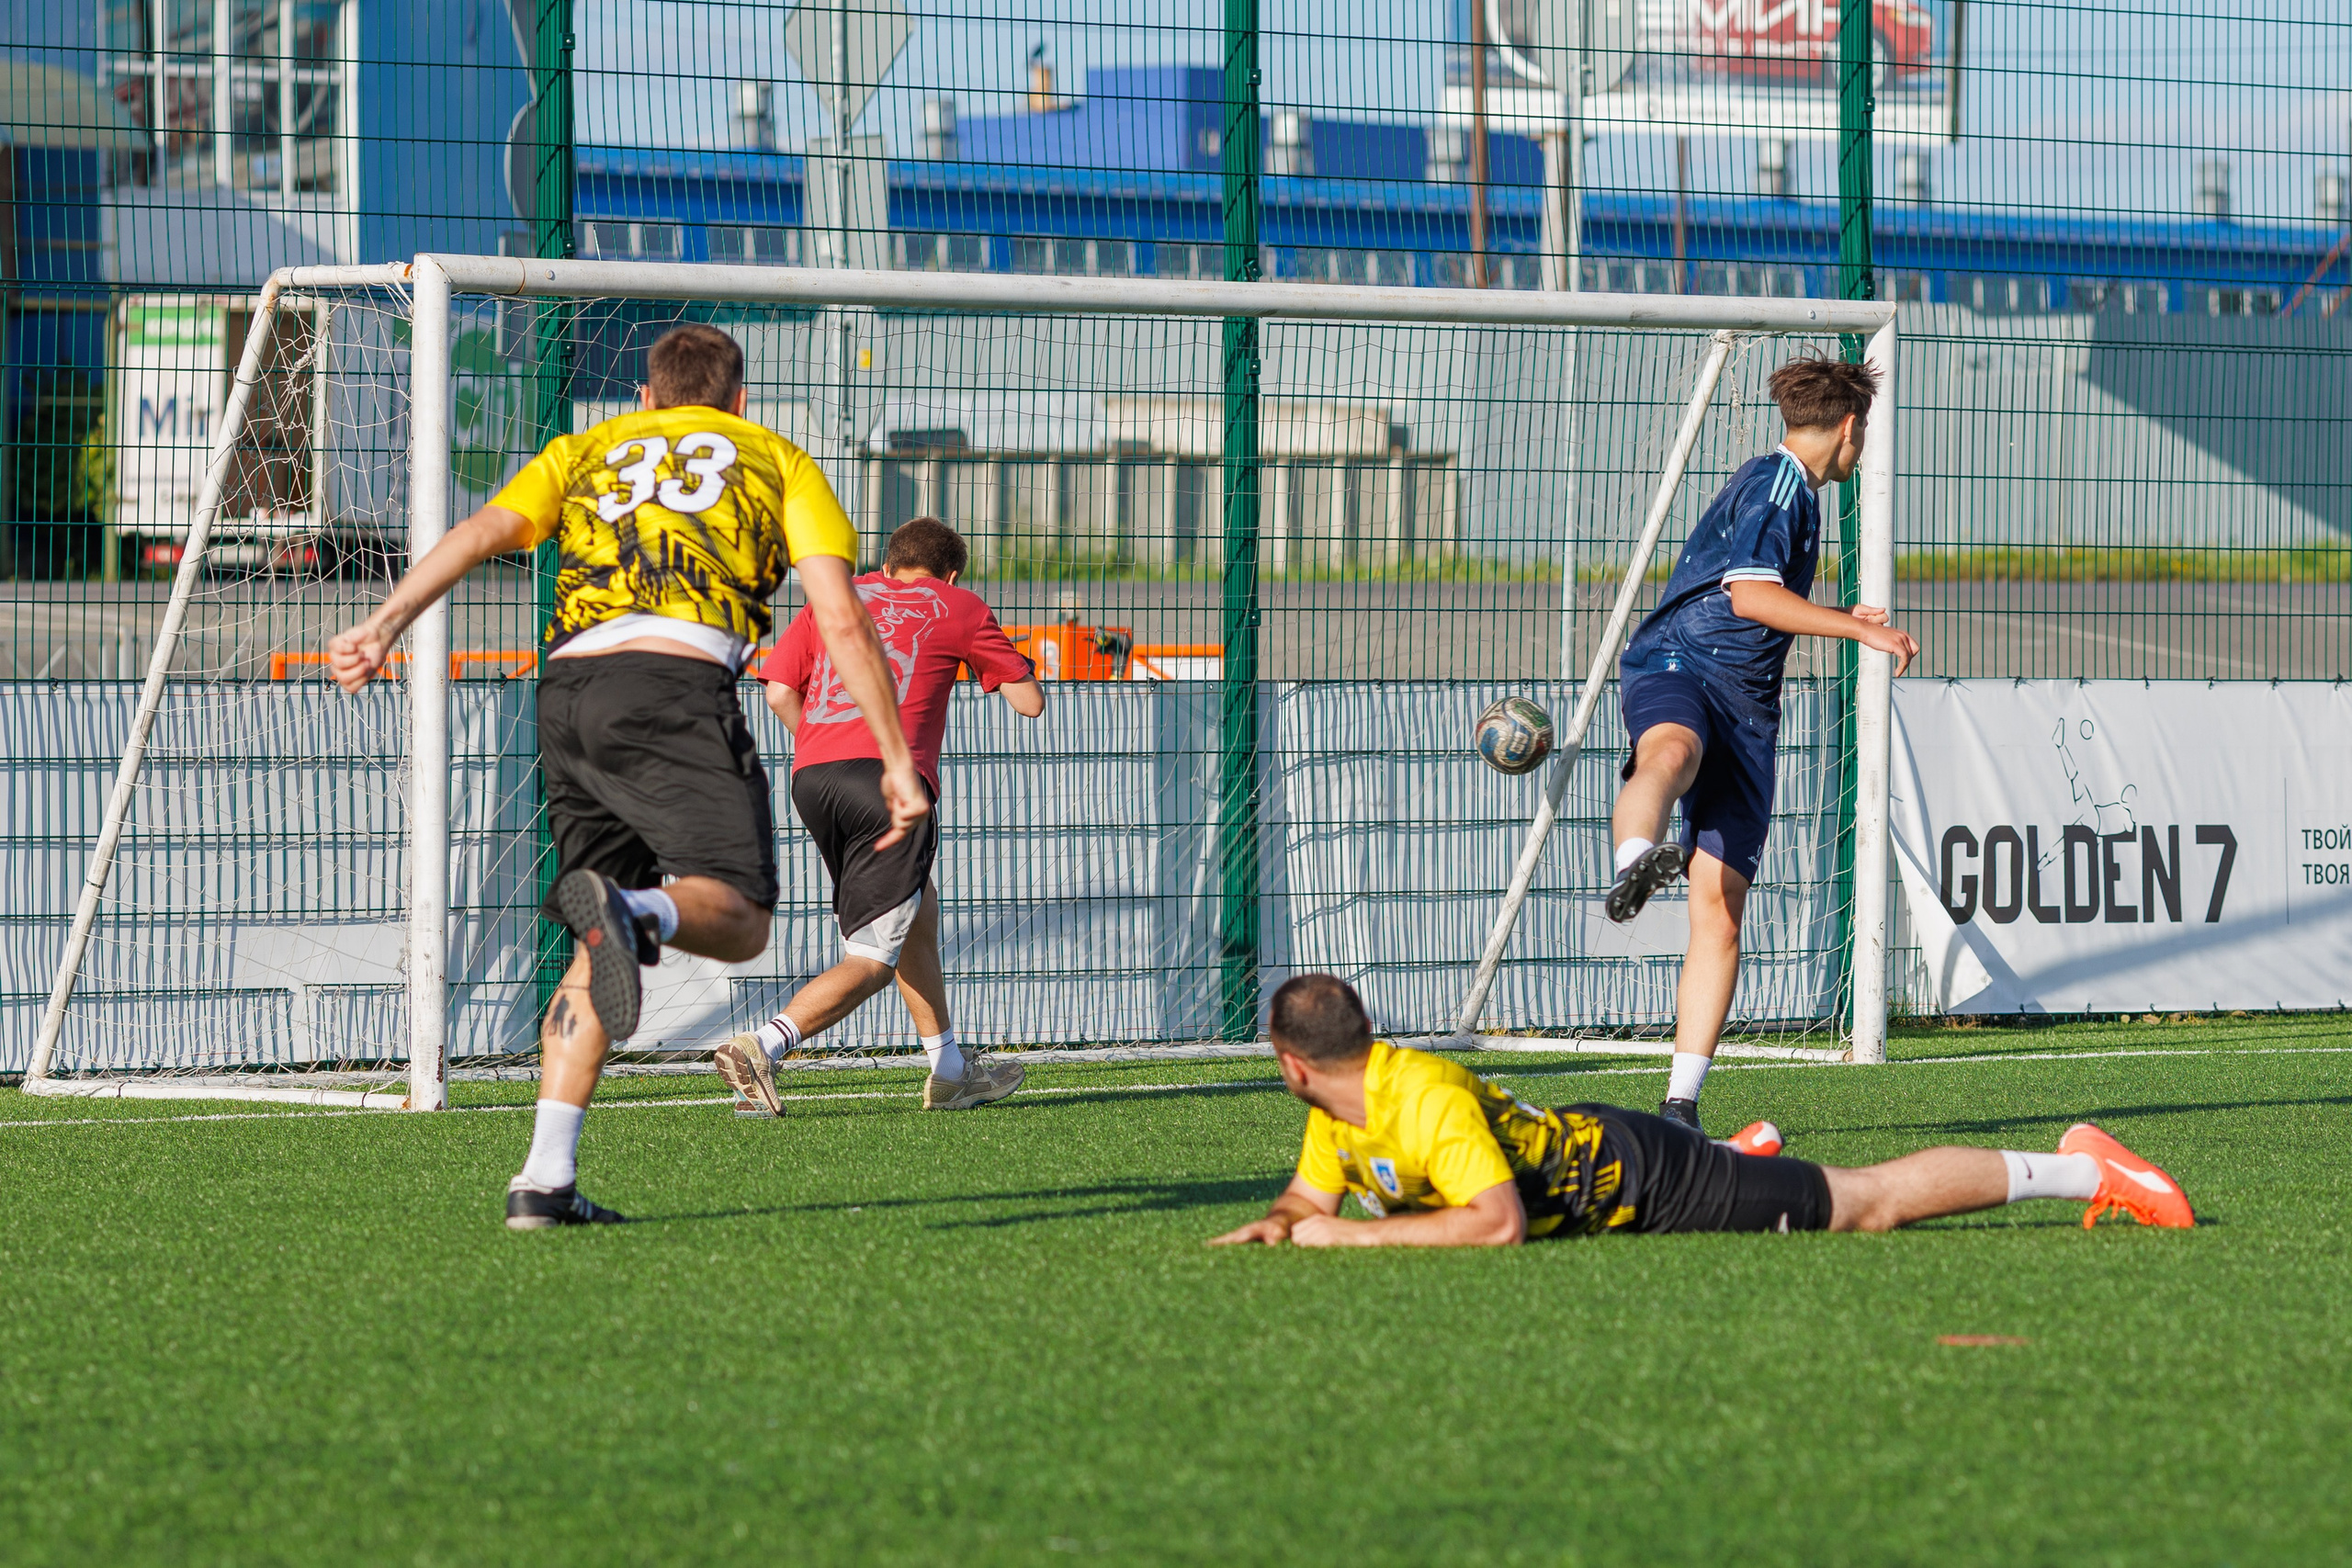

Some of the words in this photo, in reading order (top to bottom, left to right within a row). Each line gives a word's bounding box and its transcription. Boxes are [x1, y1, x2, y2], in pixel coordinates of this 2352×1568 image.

[597, 432, 738, 524] 33
[2301, 823, 2351, 850] ТВОЙ
[1939, 824, 2182, 925] GOLDEN
[2195, 824, 2238, 923] 7
[2302, 863, 2349, 885] ТВОЯ
